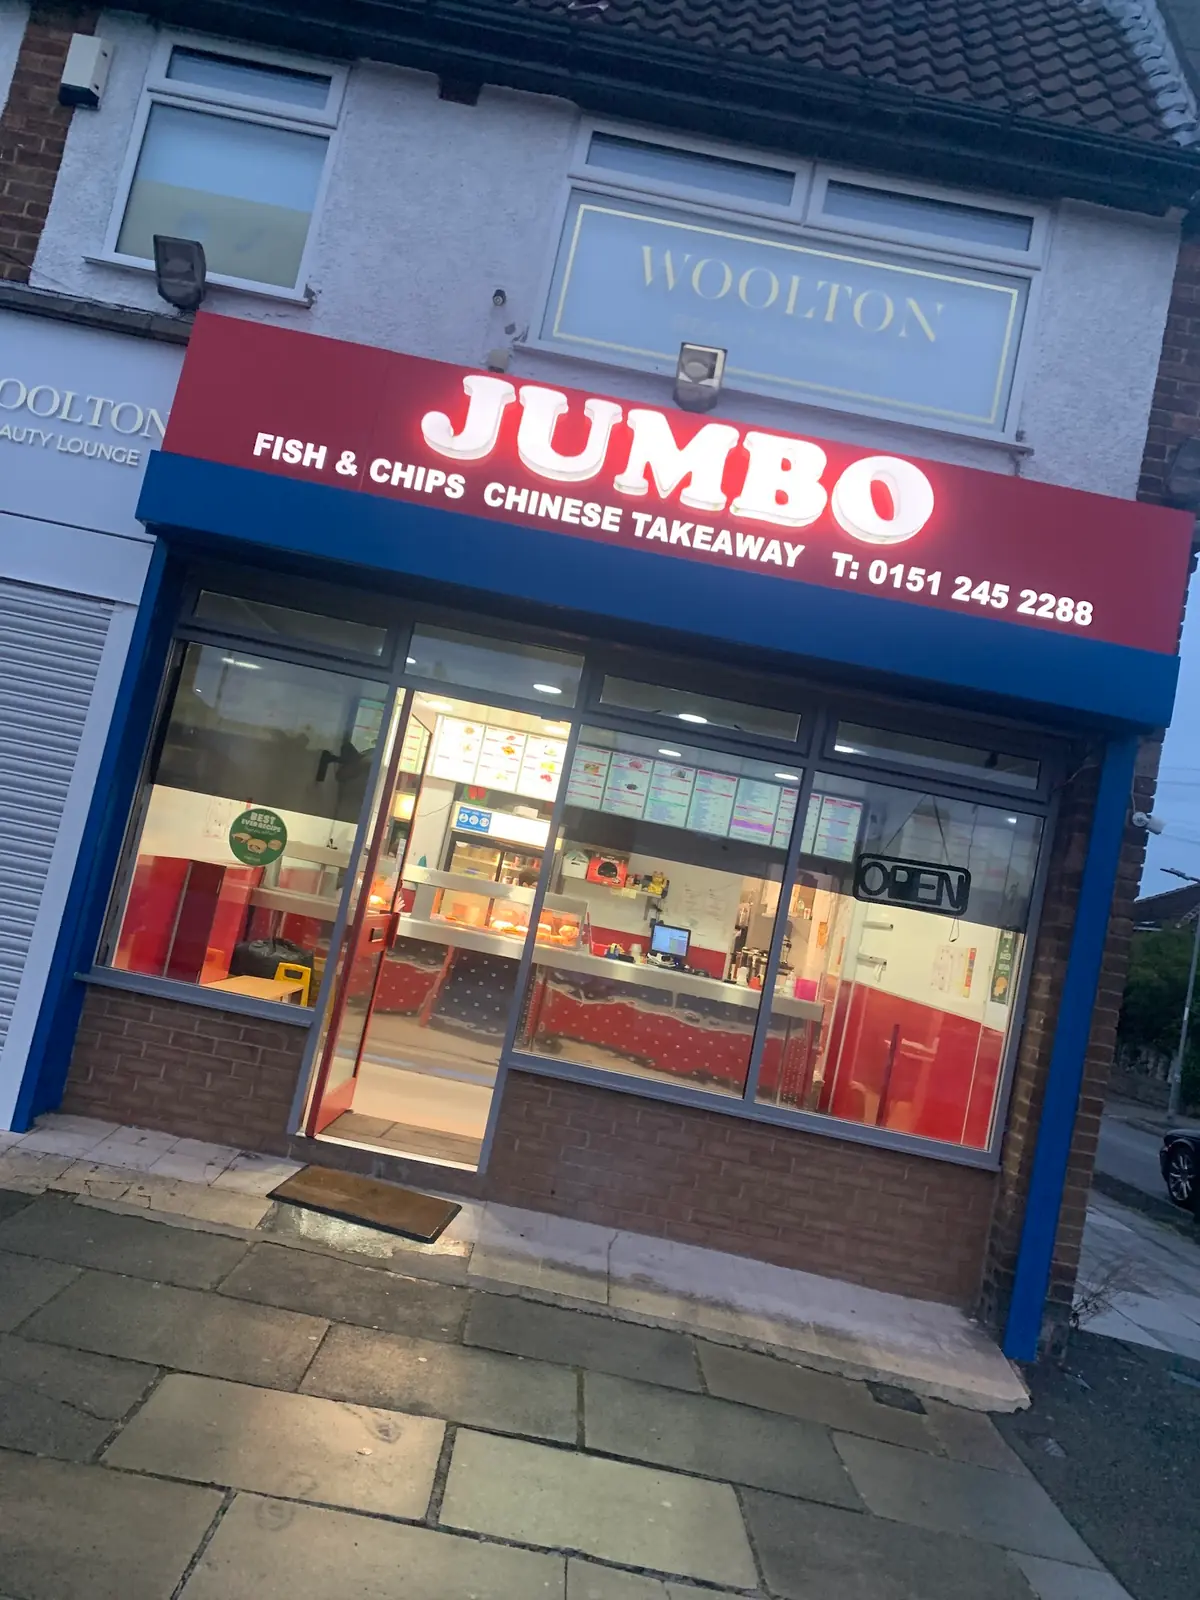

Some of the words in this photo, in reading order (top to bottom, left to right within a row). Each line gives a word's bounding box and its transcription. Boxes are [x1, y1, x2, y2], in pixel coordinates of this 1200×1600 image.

[641, 245, 945, 342] WOOLTON
[57, 435, 141, 466] LOUNGE
[421, 375, 934, 546] JUMBO
[253, 432, 327, 470] FISH
[335, 450, 359, 477] &
[369, 458, 466, 499] CHIPS
[483, 482, 622, 532] CHINESE
[632, 507, 805, 569] TAKEAWAY
[832, 552, 859, 580] T:
[868, 560, 942, 595] 0151
[951, 576, 1010, 609] 245
[1016, 588, 1094, 627] 2288
[250, 812, 276, 825] BEST
[860, 861, 966, 909] OPEN
